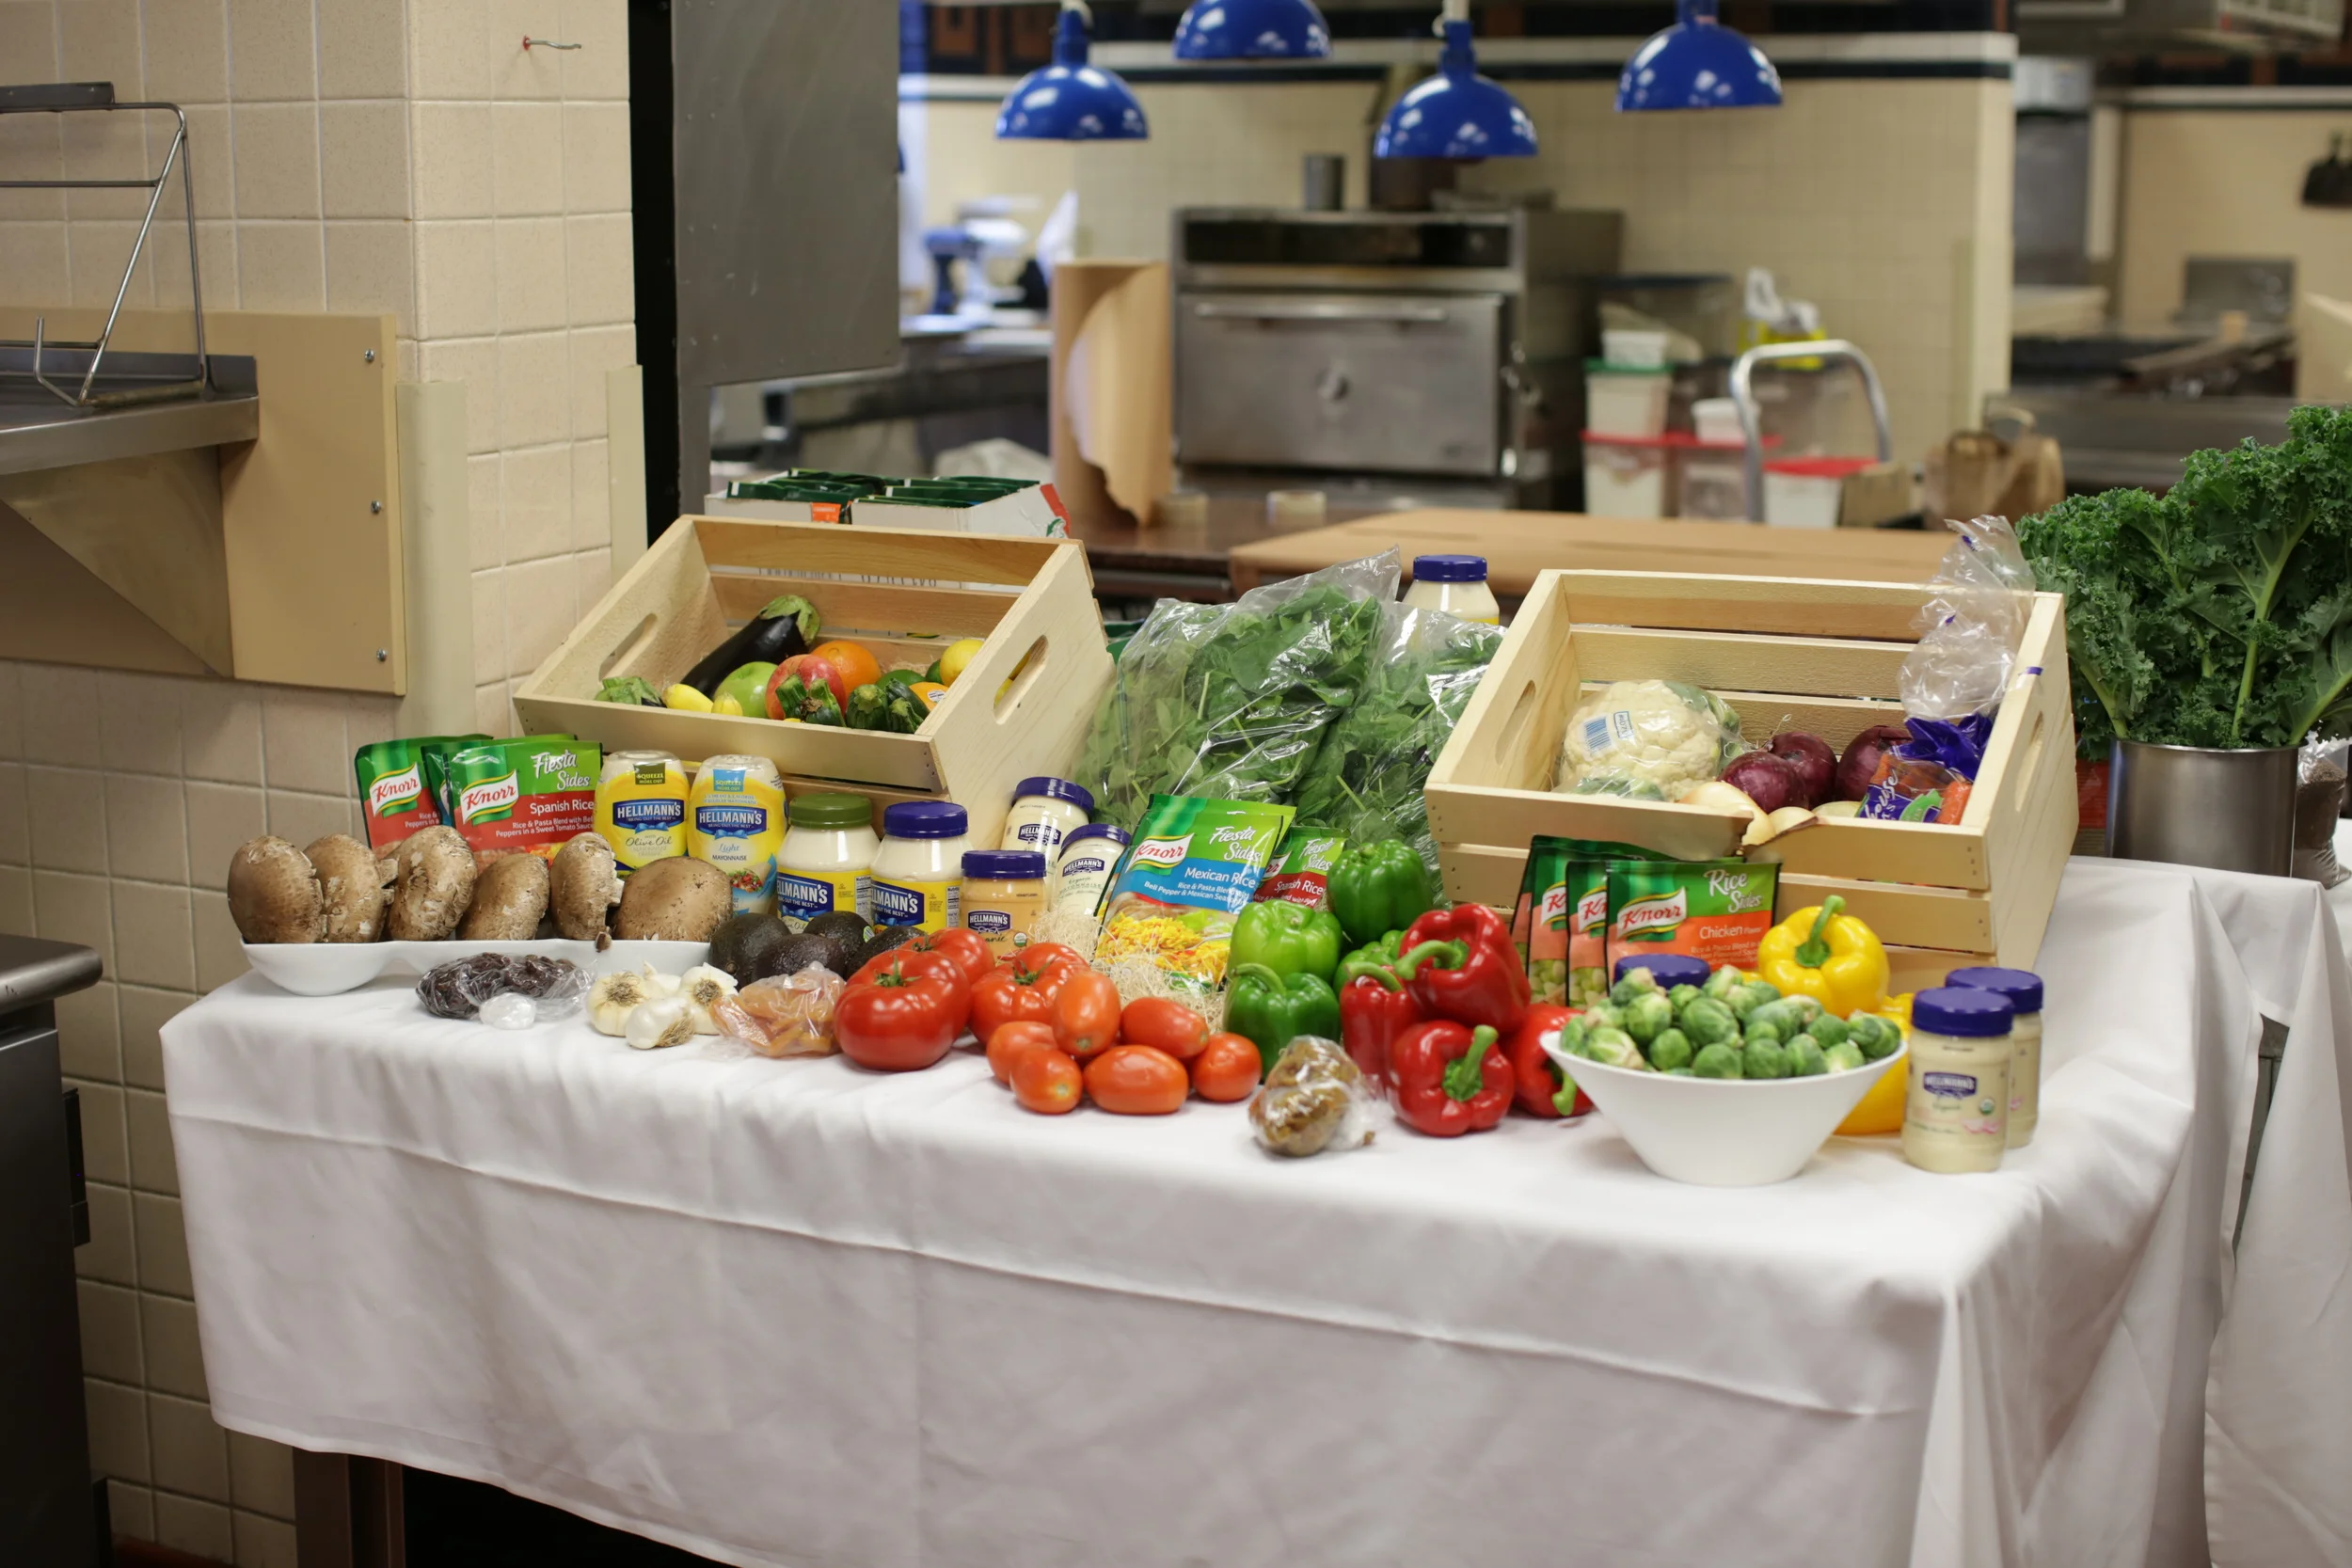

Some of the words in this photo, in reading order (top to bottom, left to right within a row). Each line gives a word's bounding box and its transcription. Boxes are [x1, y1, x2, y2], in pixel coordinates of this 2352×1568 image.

[531, 750, 578, 779] Fiesta
[373, 777, 419, 802] Knorr
[557, 770, 590, 791] Sides
[463, 784, 516, 810] Knorr
[530, 800, 570, 816] Spanish
[572, 799, 595, 811] Rice
[617, 801, 681, 818] HELLMANN'S
[699, 810, 762, 825] HELLMANN'S
[496, 830, 521, 838] Peppers
[626, 837, 654, 847] Olive
[655, 835, 673, 846] Oil
[1209, 825, 1257, 845] Fiesta
[1134, 843, 1184, 860] Knorr
[1224, 842, 1261, 862] Sides
[1302, 853, 1332, 871] Sides
[1184, 866, 1230, 882] Mexican
[1231, 872, 1256, 888] Rice
[1702, 869, 1748, 897] Rice
[1144, 880, 1157, 891] Bell
[1158, 886, 1180, 895] Pepper
[1187, 890, 1214, 899] Mexican
[1198, 883, 1216, 892] Pasta
[1302, 879, 1324, 895] Rice
[1727, 890, 1763, 913] Sides
[969, 914, 1009, 925] HELLMANN'S
[1621, 901, 1682, 930] Knorr
[1699, 925, 1743, 940] Chicken
